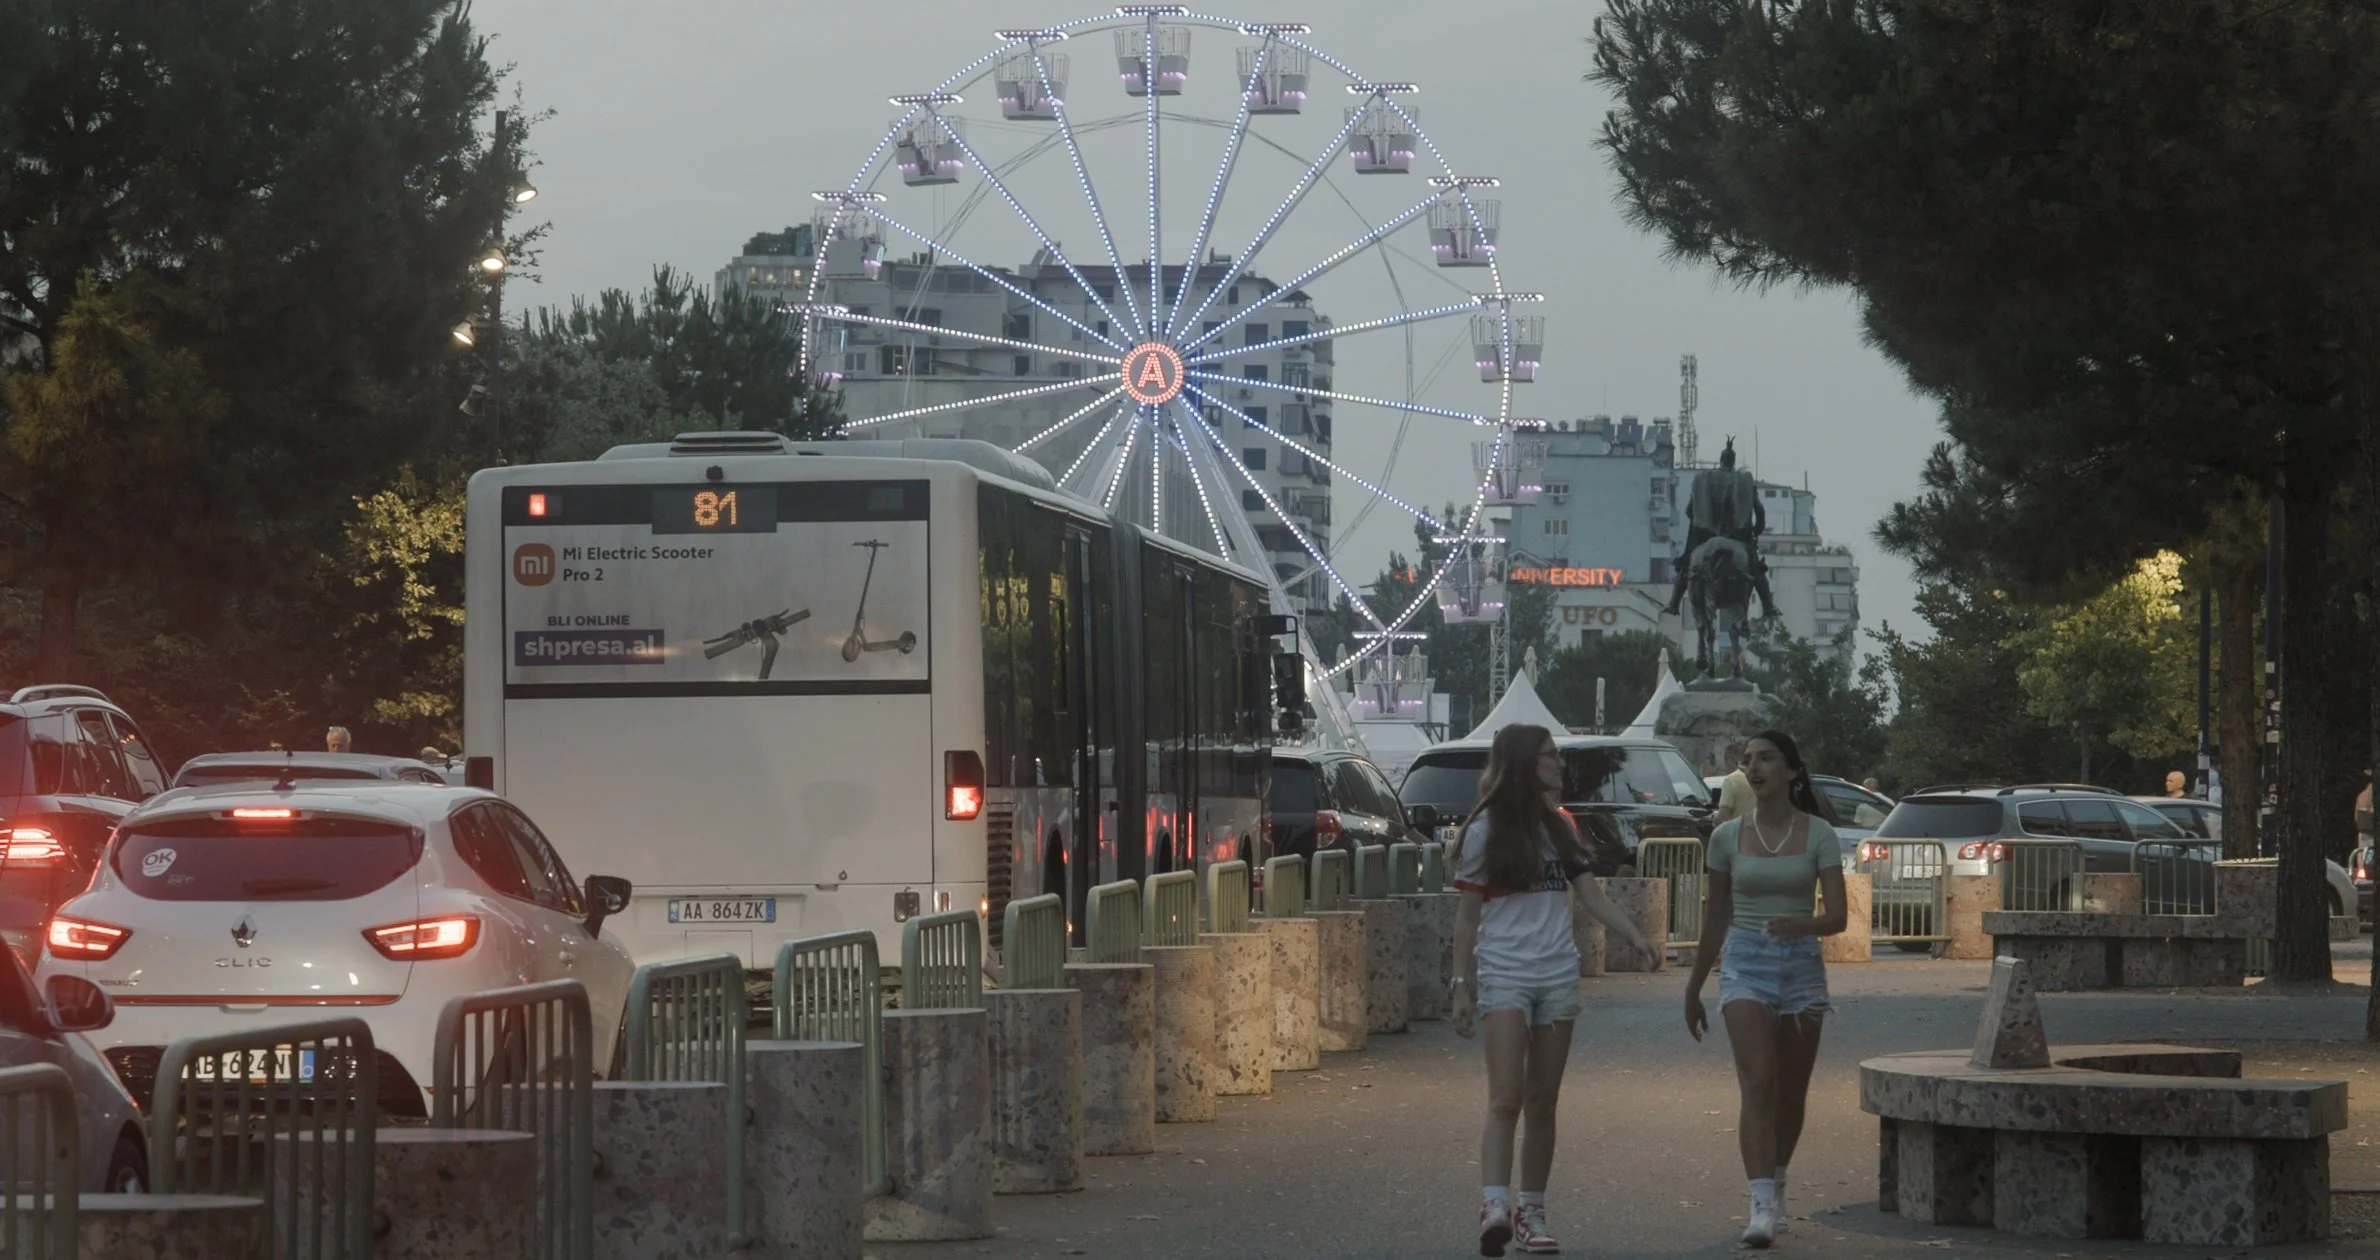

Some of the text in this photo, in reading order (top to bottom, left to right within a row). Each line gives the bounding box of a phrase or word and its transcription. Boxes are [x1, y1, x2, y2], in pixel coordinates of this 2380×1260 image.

[1137, 352, 1166, 388] A
[694, 491, 737, 526] 81
[563, 546, 714, 560] Mi Electric Scooter
[563, 568, 604, 581] Pro 2
[548, 615, 631, 627] BLI ONLINE
[1563, 605, 1618, 626] UFO
[524, 635, 655, 661] shpresa.al
[144, 851, 174, 866] OK
[683, 902, 703, 920] AA
[215, 957, 273, 968] CLIO
